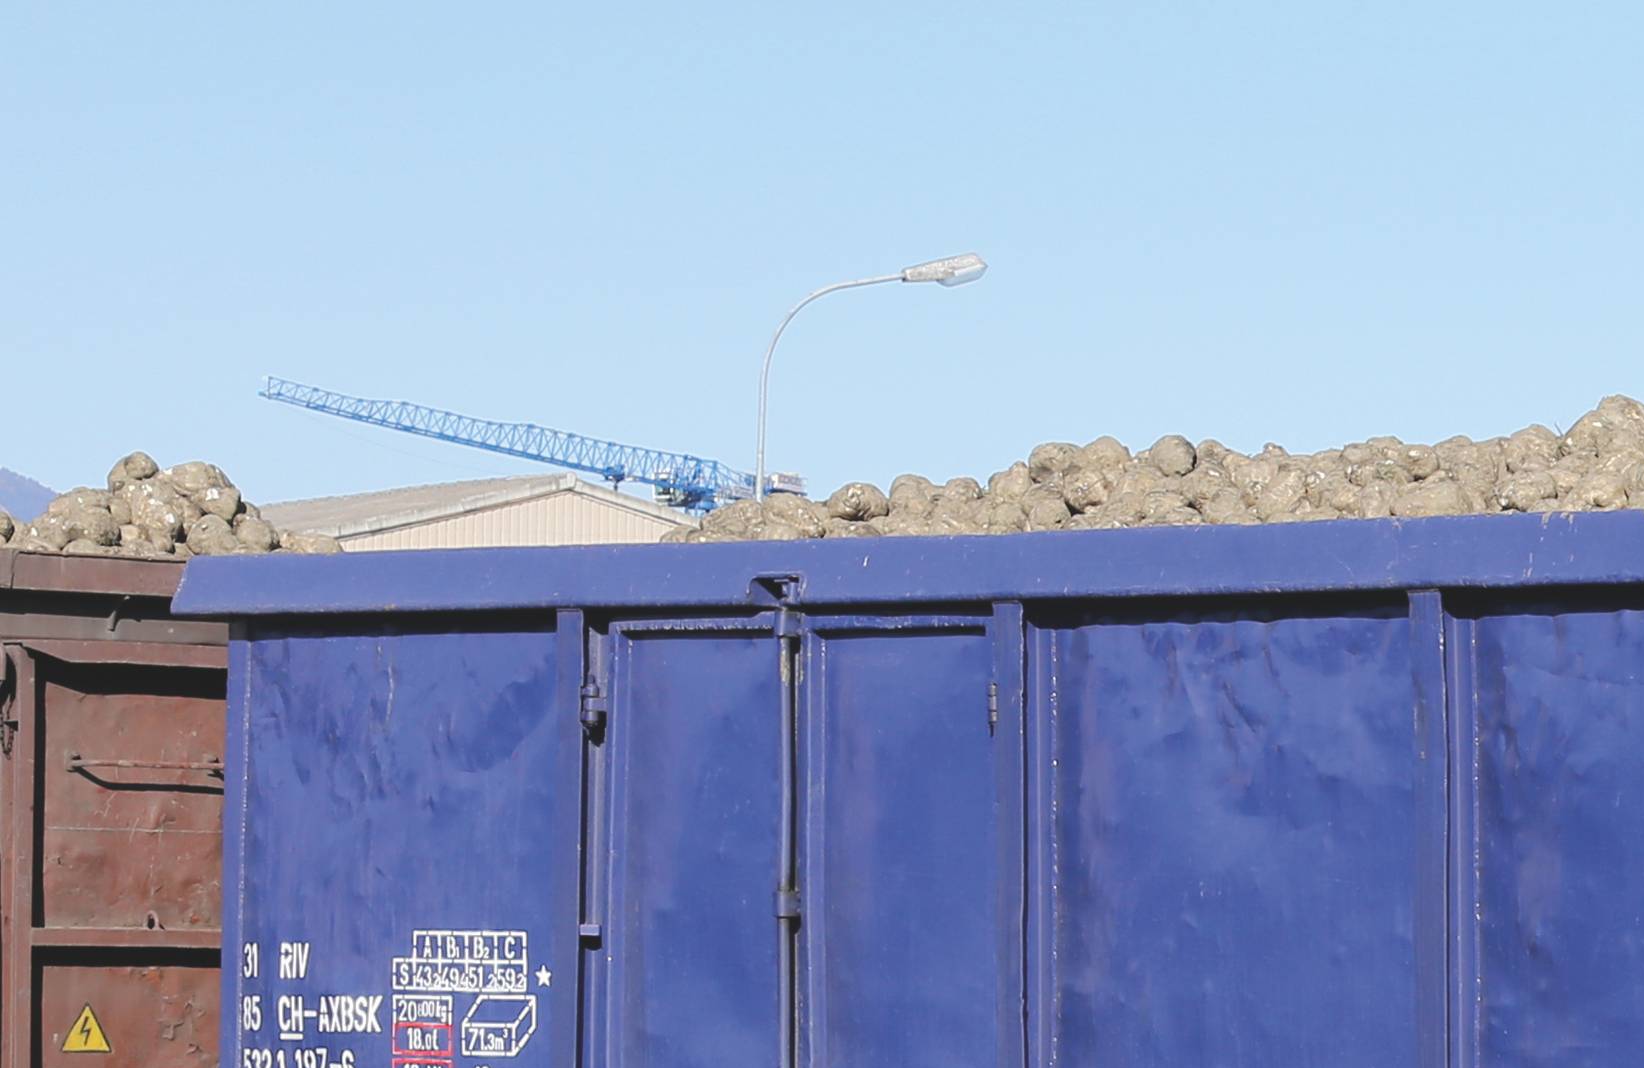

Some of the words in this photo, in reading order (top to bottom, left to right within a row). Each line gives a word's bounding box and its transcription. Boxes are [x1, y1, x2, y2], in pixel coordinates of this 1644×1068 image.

[423, 936, 433, 957] A
[504, 936, 516, 959] C
[243, 942, 259, 979] 31
[279, 942, 310, 979] RIV
[400, 963, 410, 985] S
[243, 996, 261, 1031] 85
[277, 995, 383, 1033] CH-AXBSK
